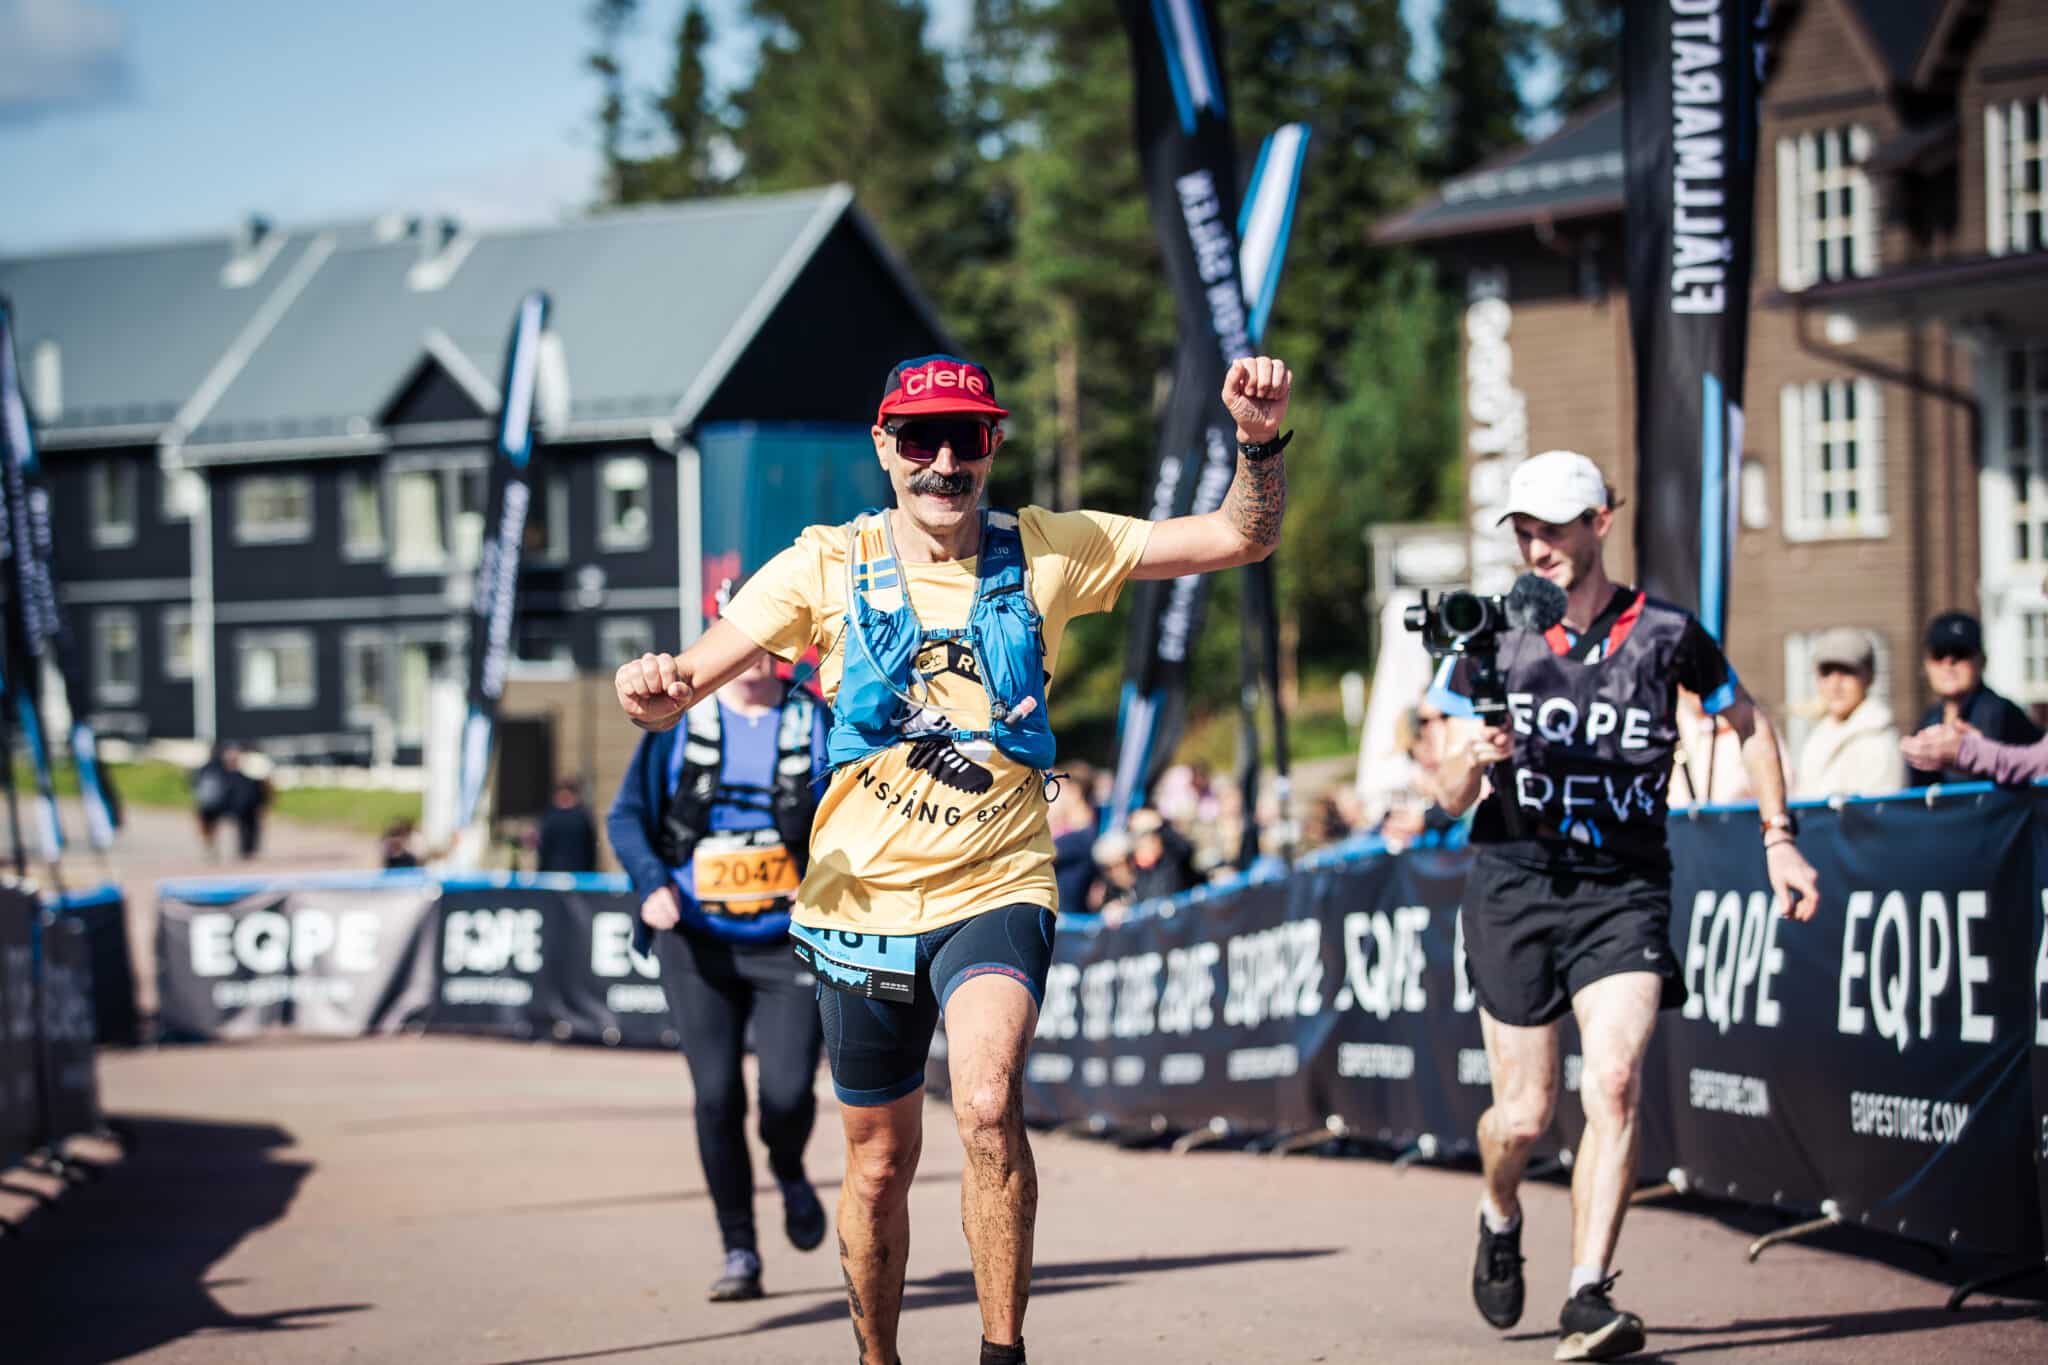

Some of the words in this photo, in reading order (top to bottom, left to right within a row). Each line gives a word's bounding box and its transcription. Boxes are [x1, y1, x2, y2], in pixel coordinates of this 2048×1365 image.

[906, 368, 984, 396] ciele
[1507, 693, 1651, 749] EQPE
[712, 857, 790, 887] 2047
[189, 910, 382, 976] EQPE
[1682, 889, 1785, 1035] EQPE
[1838, 889, 1995, 1052] EQPE
